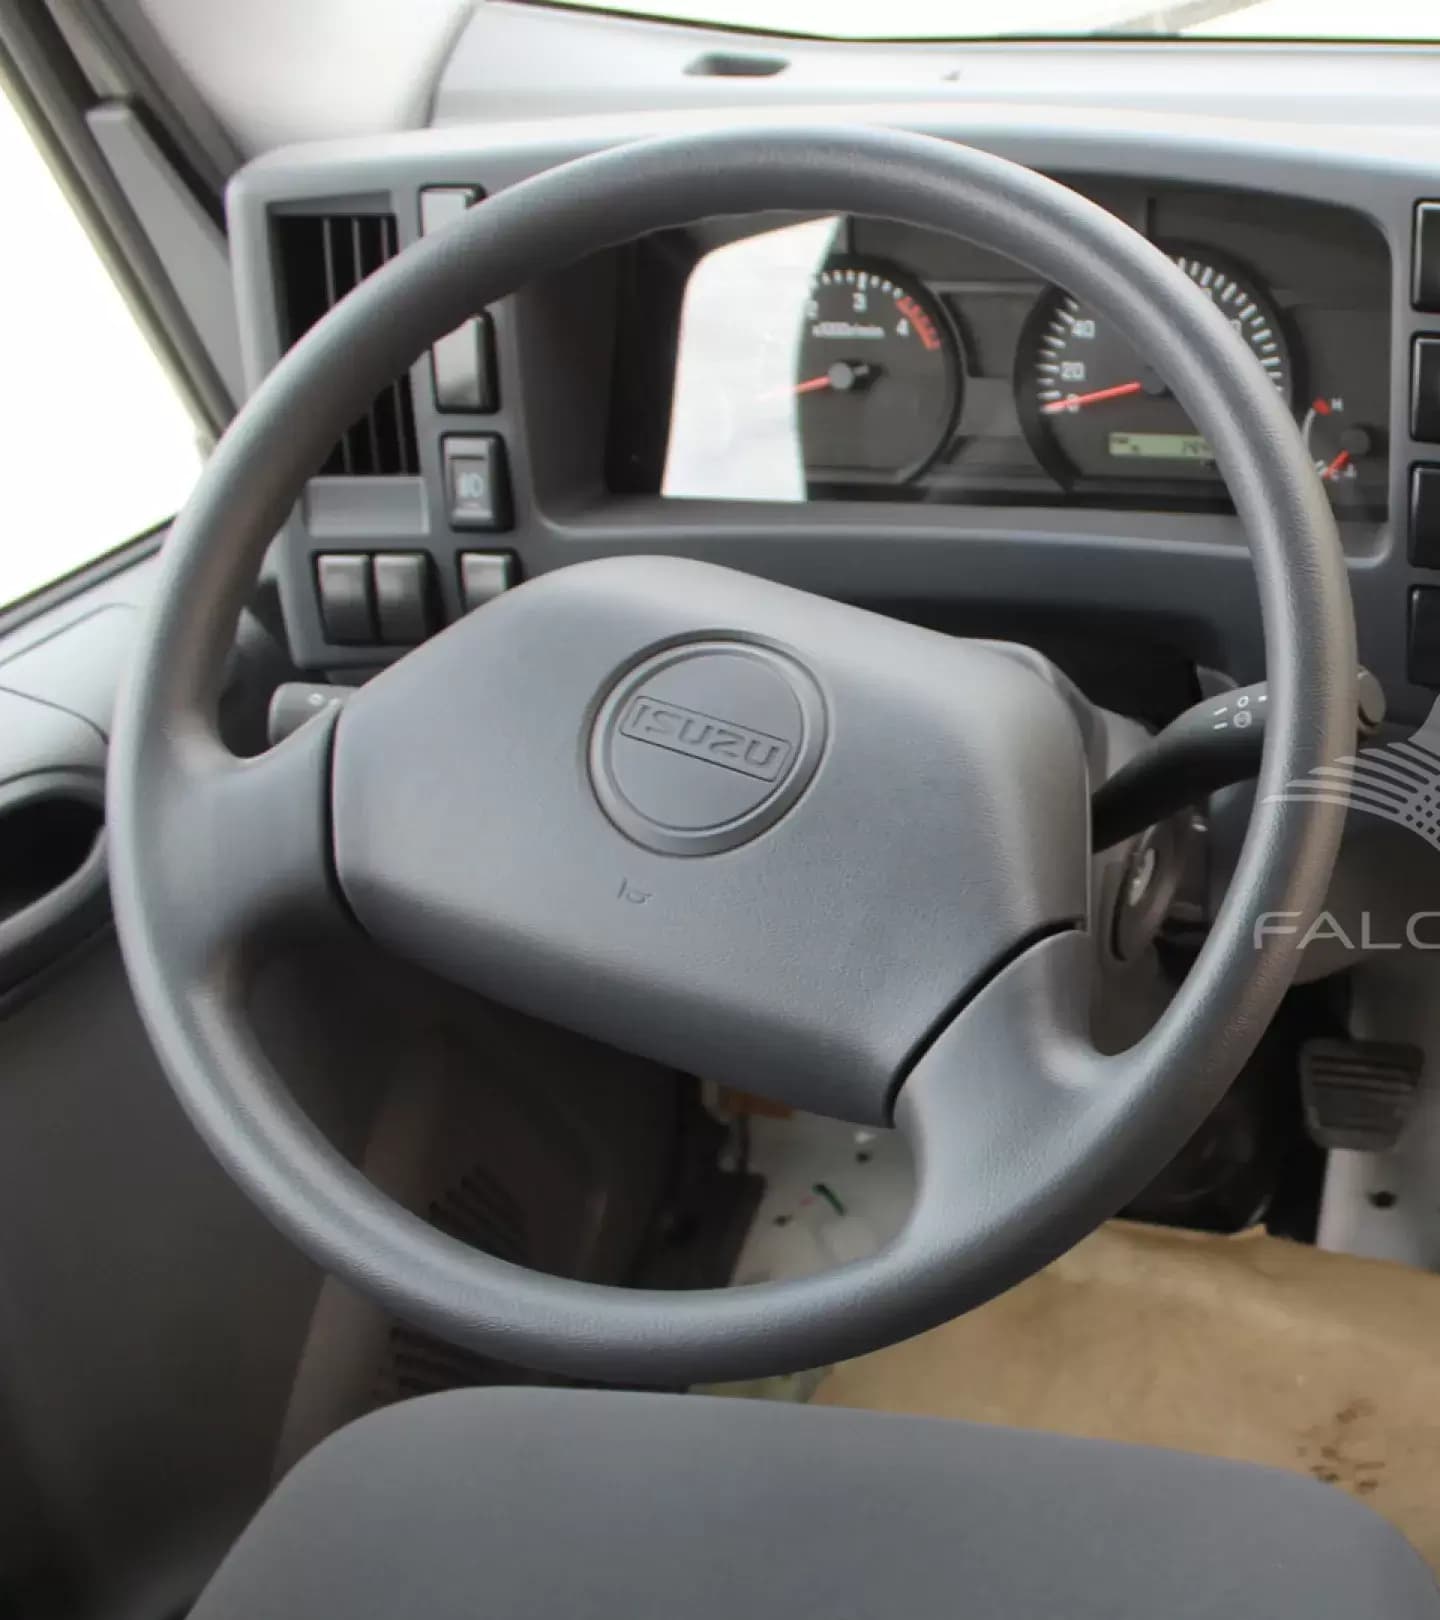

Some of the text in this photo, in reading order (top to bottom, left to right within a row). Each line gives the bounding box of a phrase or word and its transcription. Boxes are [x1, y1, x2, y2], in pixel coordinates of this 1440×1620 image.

[852, 291, 867, 313] 3
[895, 317, 910, 337] 4
[1071, 319, 1096, 339] 40
[1060, 360, 1086, 382] 20
[630, 703, 780, 767] ISUZU
